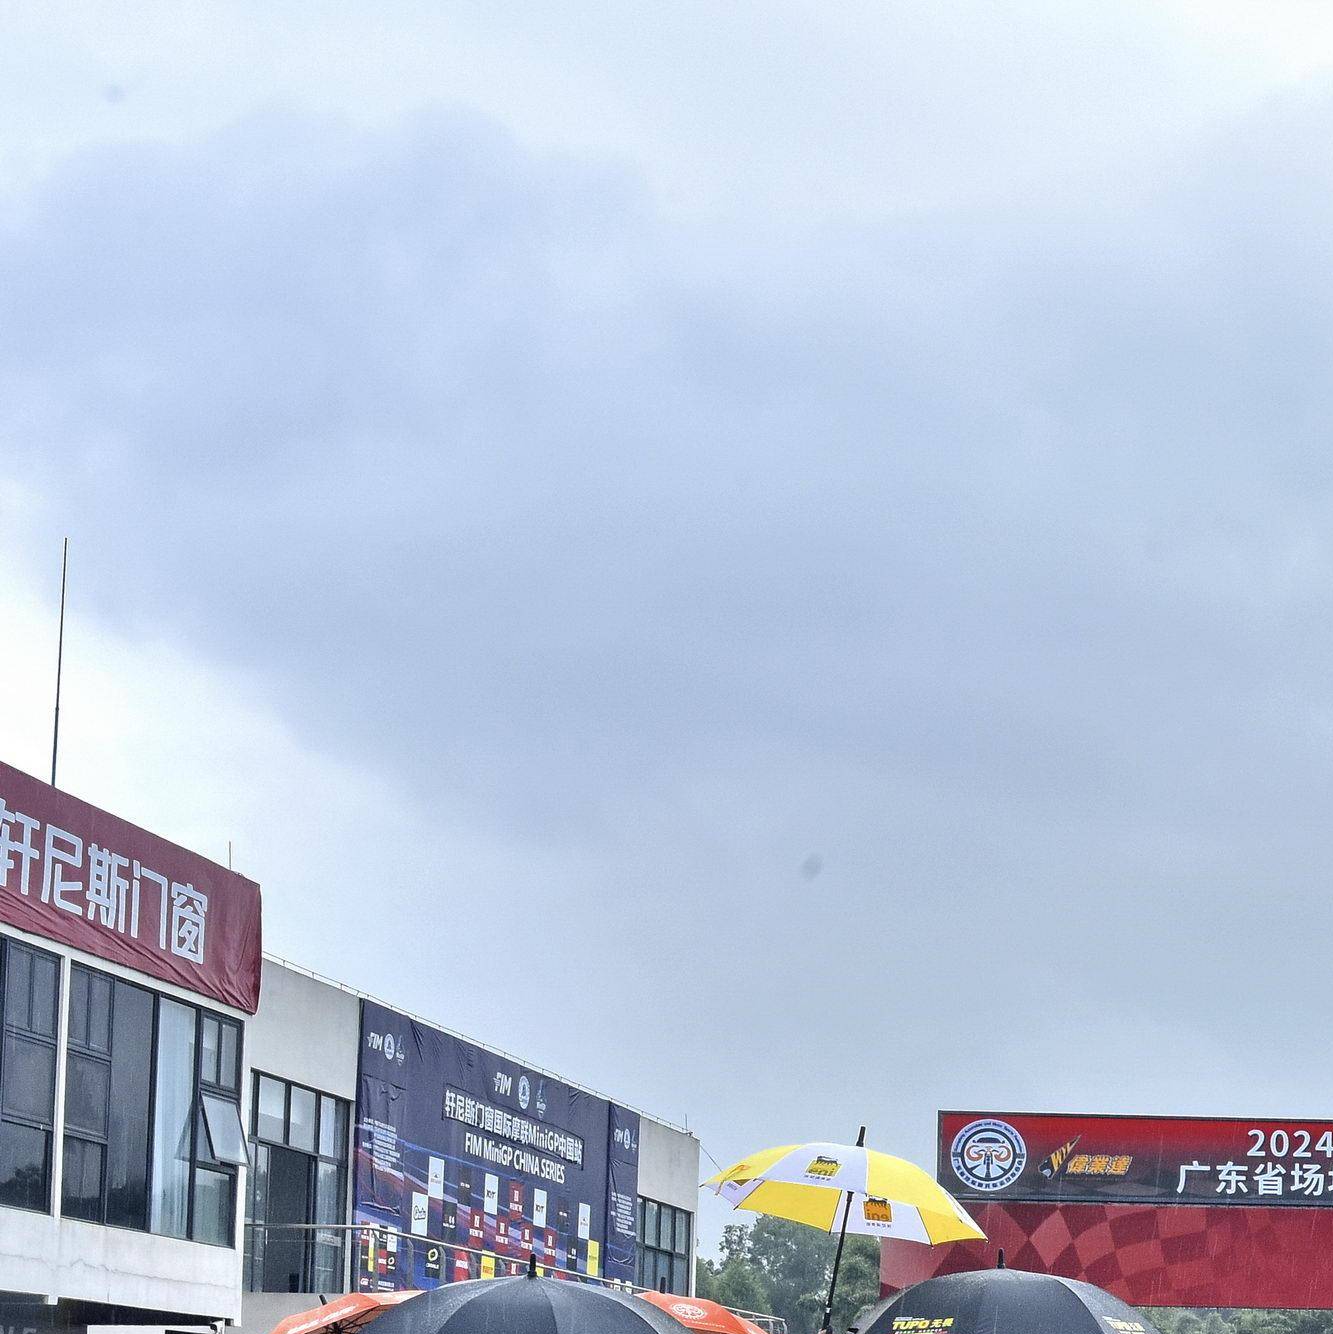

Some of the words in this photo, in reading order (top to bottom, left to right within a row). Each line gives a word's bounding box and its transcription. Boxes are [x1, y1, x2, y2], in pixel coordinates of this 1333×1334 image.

[0, 806, 208, 965] 轩尼斯门窗
[465, 1132, 482, 1157] FIM
[483, 1139, 513, 1167] MiniGP
[514, 1149, 541, 1177] CHINA
[541, 1158, 566, 1185] SERIES
[892, 1320, 931, 1331] TUPO
